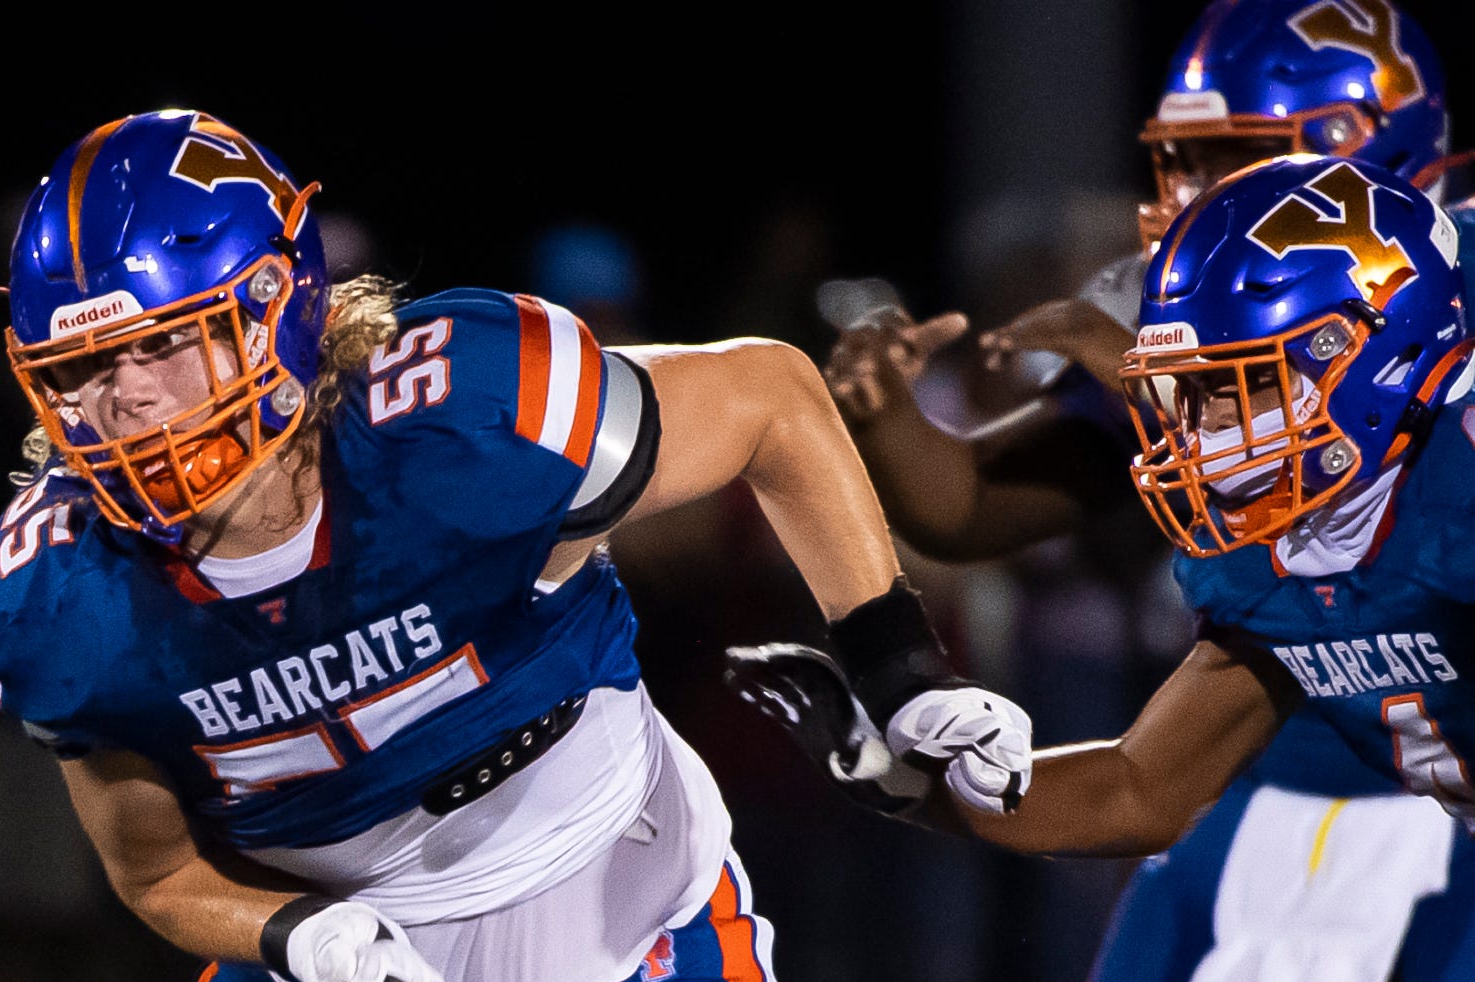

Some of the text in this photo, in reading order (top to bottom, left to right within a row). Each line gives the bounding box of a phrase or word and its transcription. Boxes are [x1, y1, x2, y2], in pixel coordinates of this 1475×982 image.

[169, 110, 308, 242] Y
[1245, 161, 1420, 312] Y
[368, 316, 454, 428] 55
[179, 603, 443, 738] BEARCATS
[1273, 632, 1459, 698] BEARCATS
